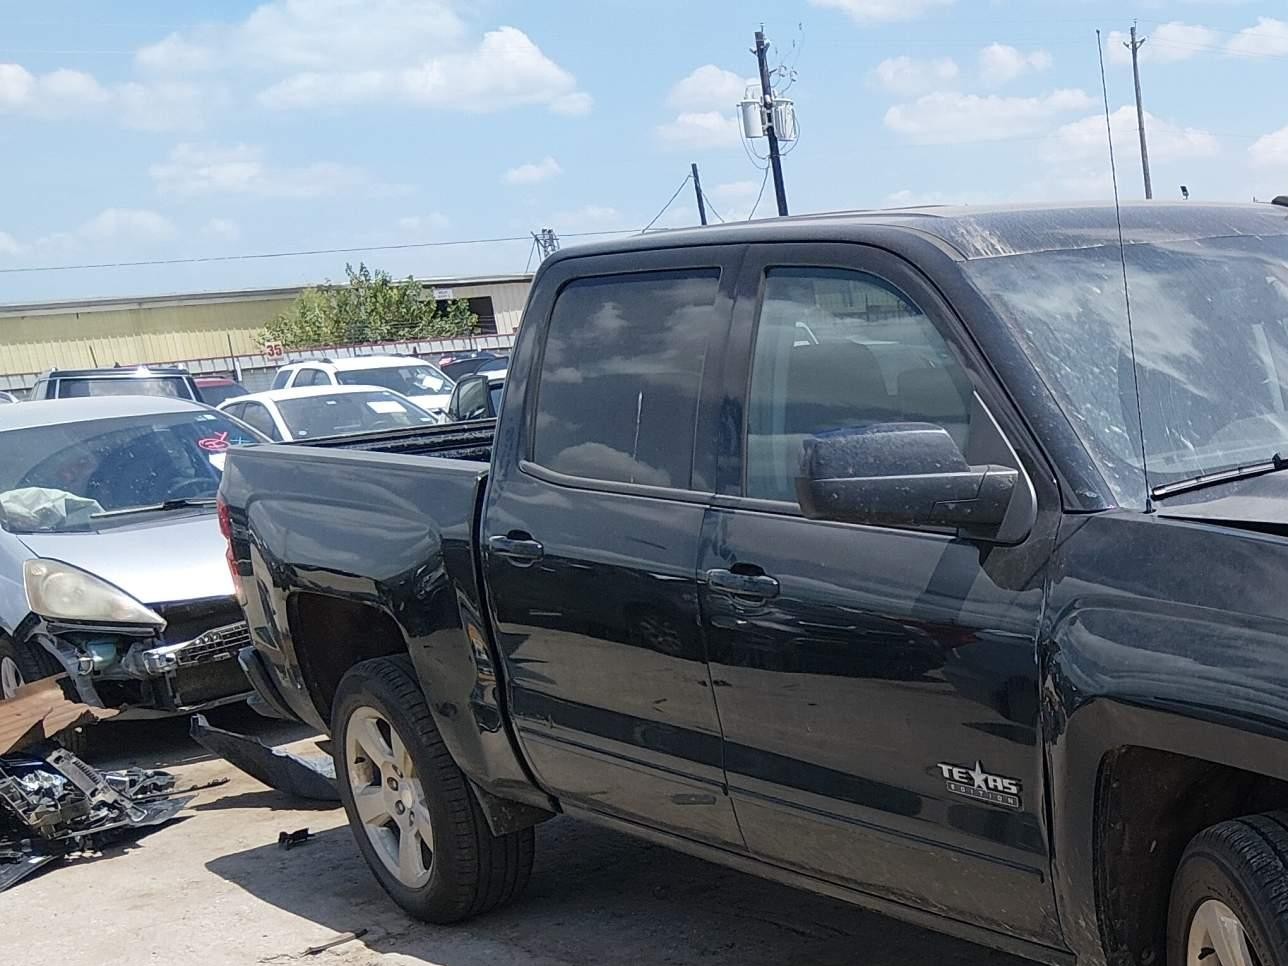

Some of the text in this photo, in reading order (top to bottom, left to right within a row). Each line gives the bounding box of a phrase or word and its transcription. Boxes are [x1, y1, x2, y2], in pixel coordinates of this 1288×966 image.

[266, 344, 283, 357] 35
[936, 759, 1018, 794] TEXAS
[950, 783, 1014, 804] EDITION
